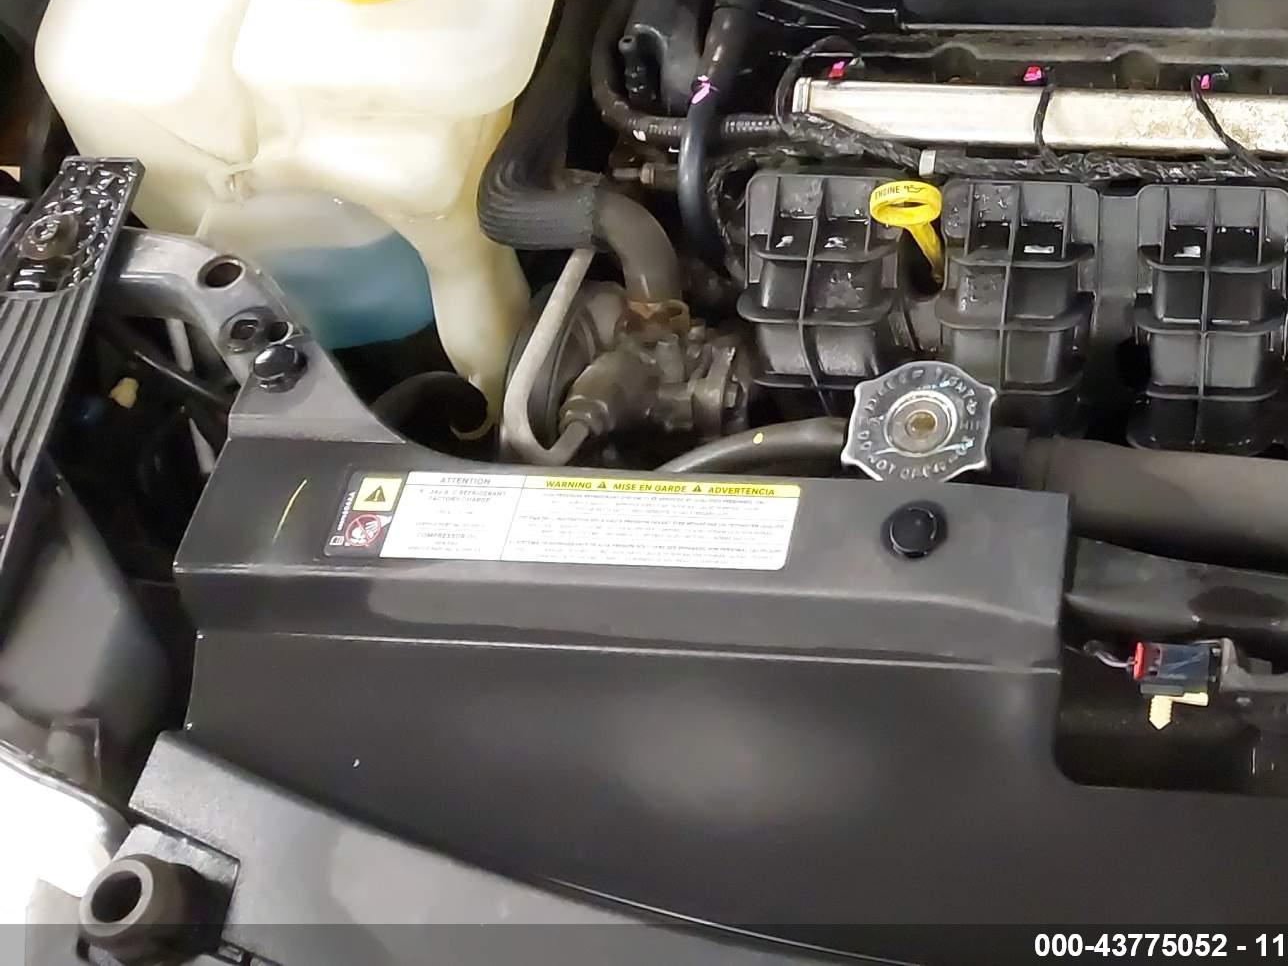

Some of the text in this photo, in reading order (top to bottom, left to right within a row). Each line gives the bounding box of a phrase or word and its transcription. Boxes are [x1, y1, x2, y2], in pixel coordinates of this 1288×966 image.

[874, 186, 900, 200] ENGINE
[440, 477, 492, 486] ATTENTION
[546, 480, 592, 489] WARNING
[639, 484, 652, 492] EN
[655, 485, 687, 493] GARDE
[708, 487, 775, 496] ADVERTENCIA
